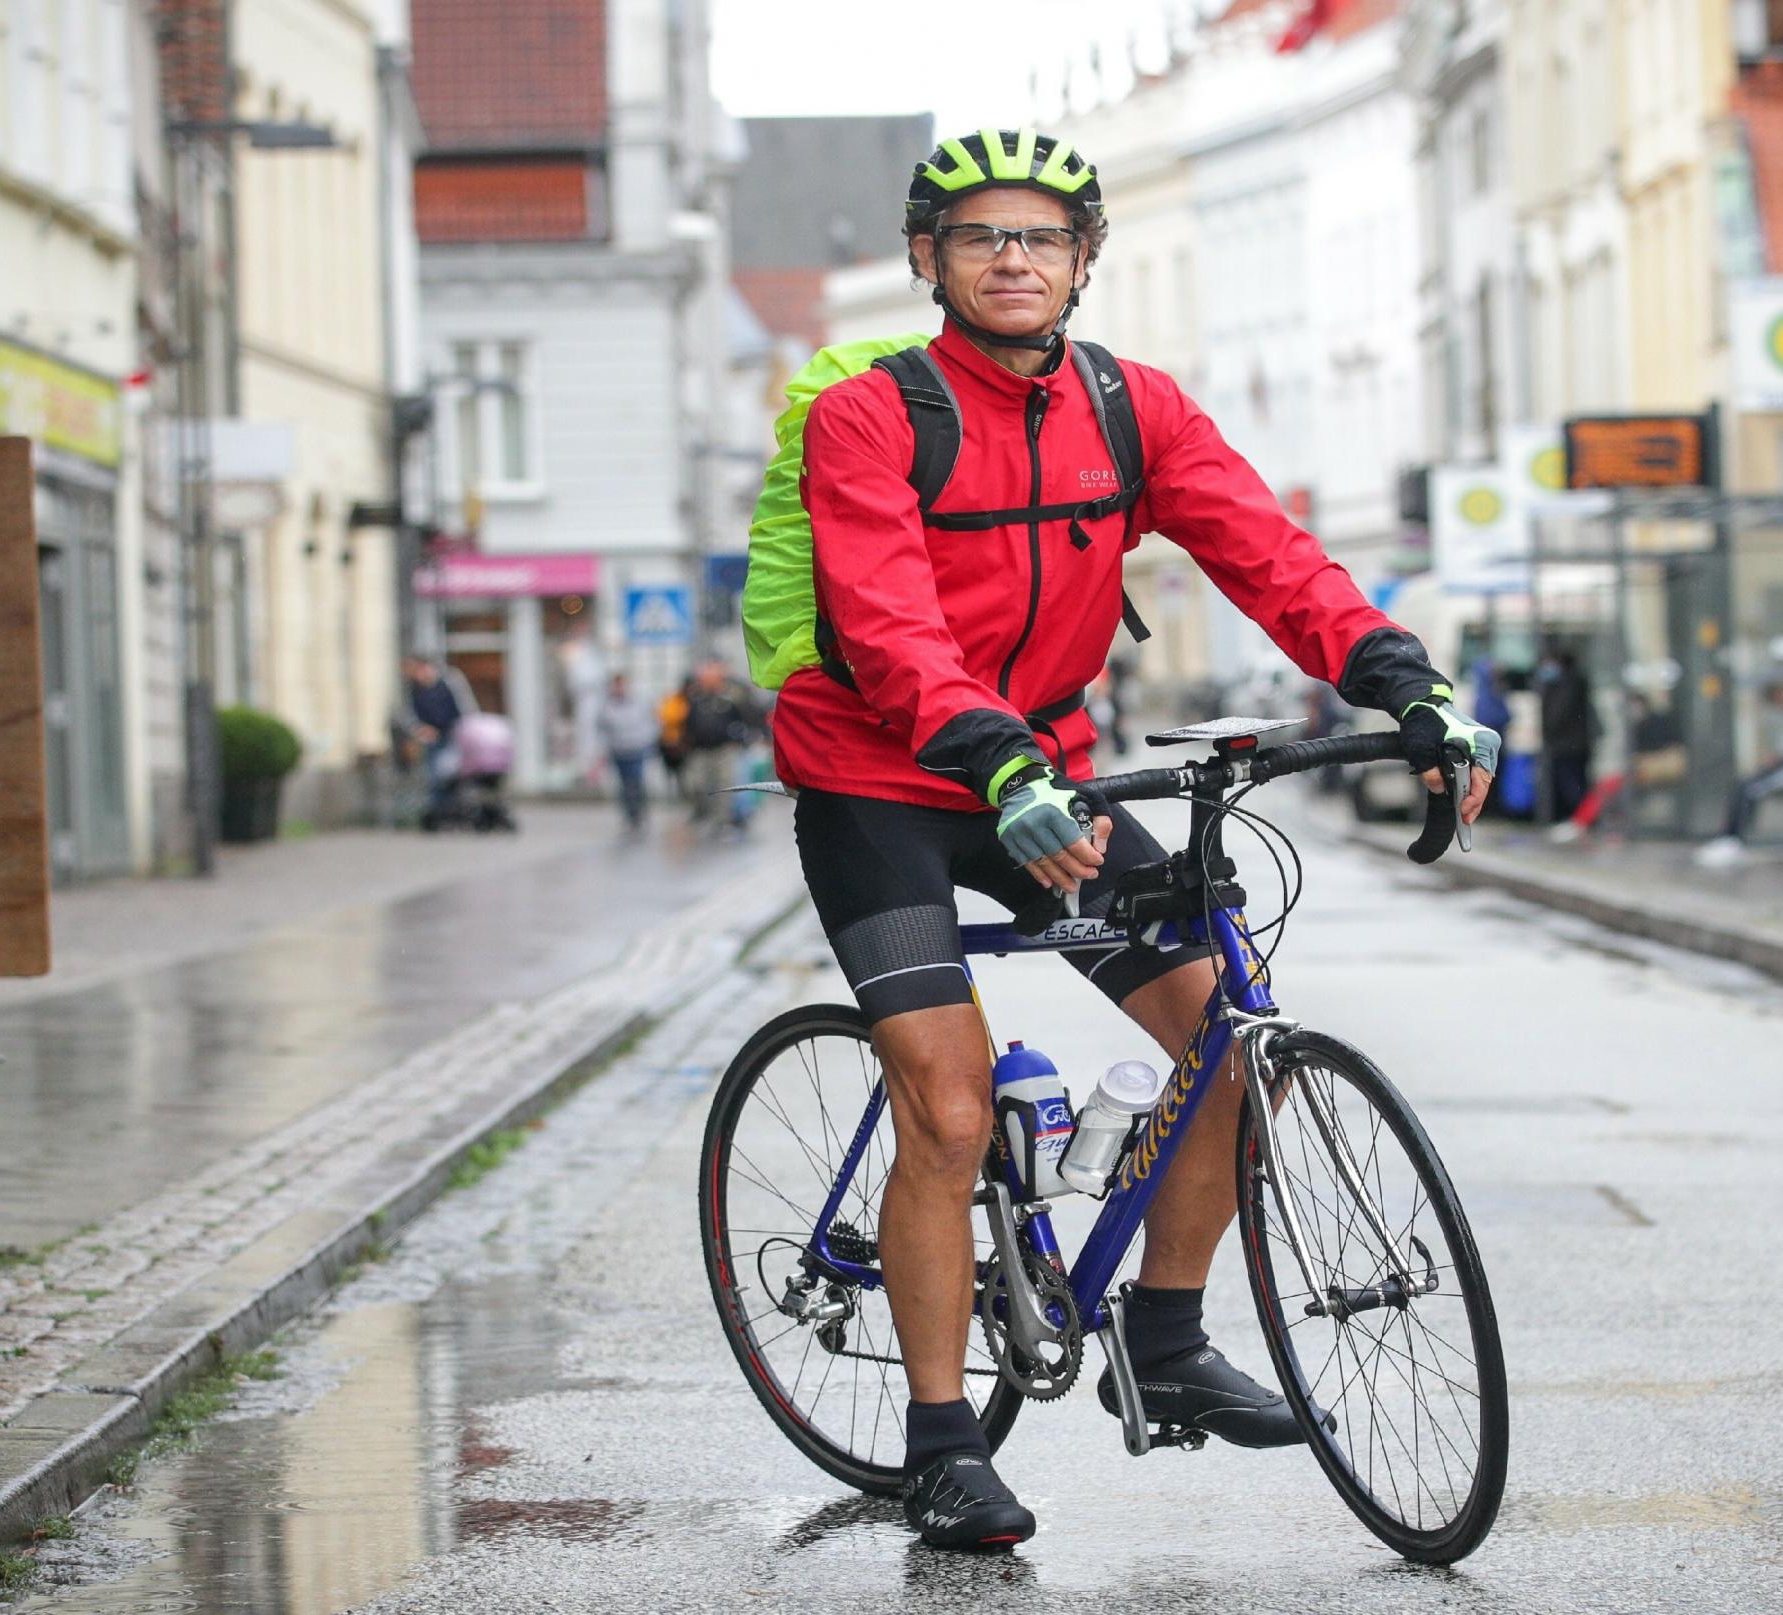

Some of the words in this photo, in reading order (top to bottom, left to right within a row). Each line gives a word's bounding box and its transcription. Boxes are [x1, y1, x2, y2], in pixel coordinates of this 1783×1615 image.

[1079, 470, 1117, 481] GORE
[1043, 922, 1128, 941] ESCAPE
[1136, 1384, 1183, 1394] THWAVE
